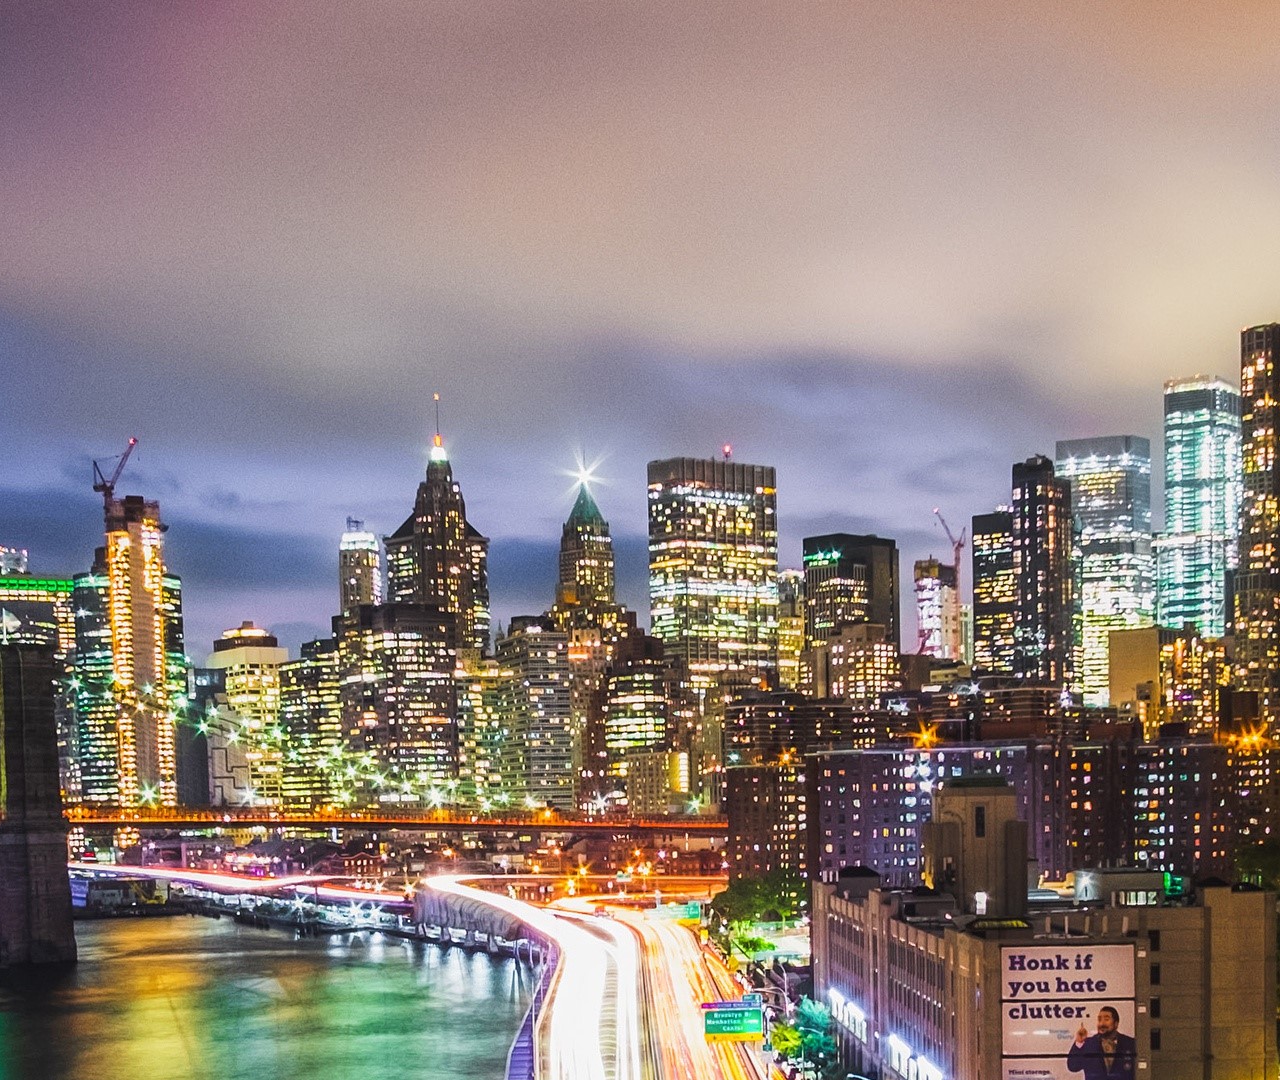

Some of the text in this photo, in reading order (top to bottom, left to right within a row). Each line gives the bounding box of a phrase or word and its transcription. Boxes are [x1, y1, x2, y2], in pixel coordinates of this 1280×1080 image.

[1008, 954, 1093, 971] Honk if
[1008, 977, 1107, 997] you hate
[1008, 1003, 1090, 1019] clutter.
